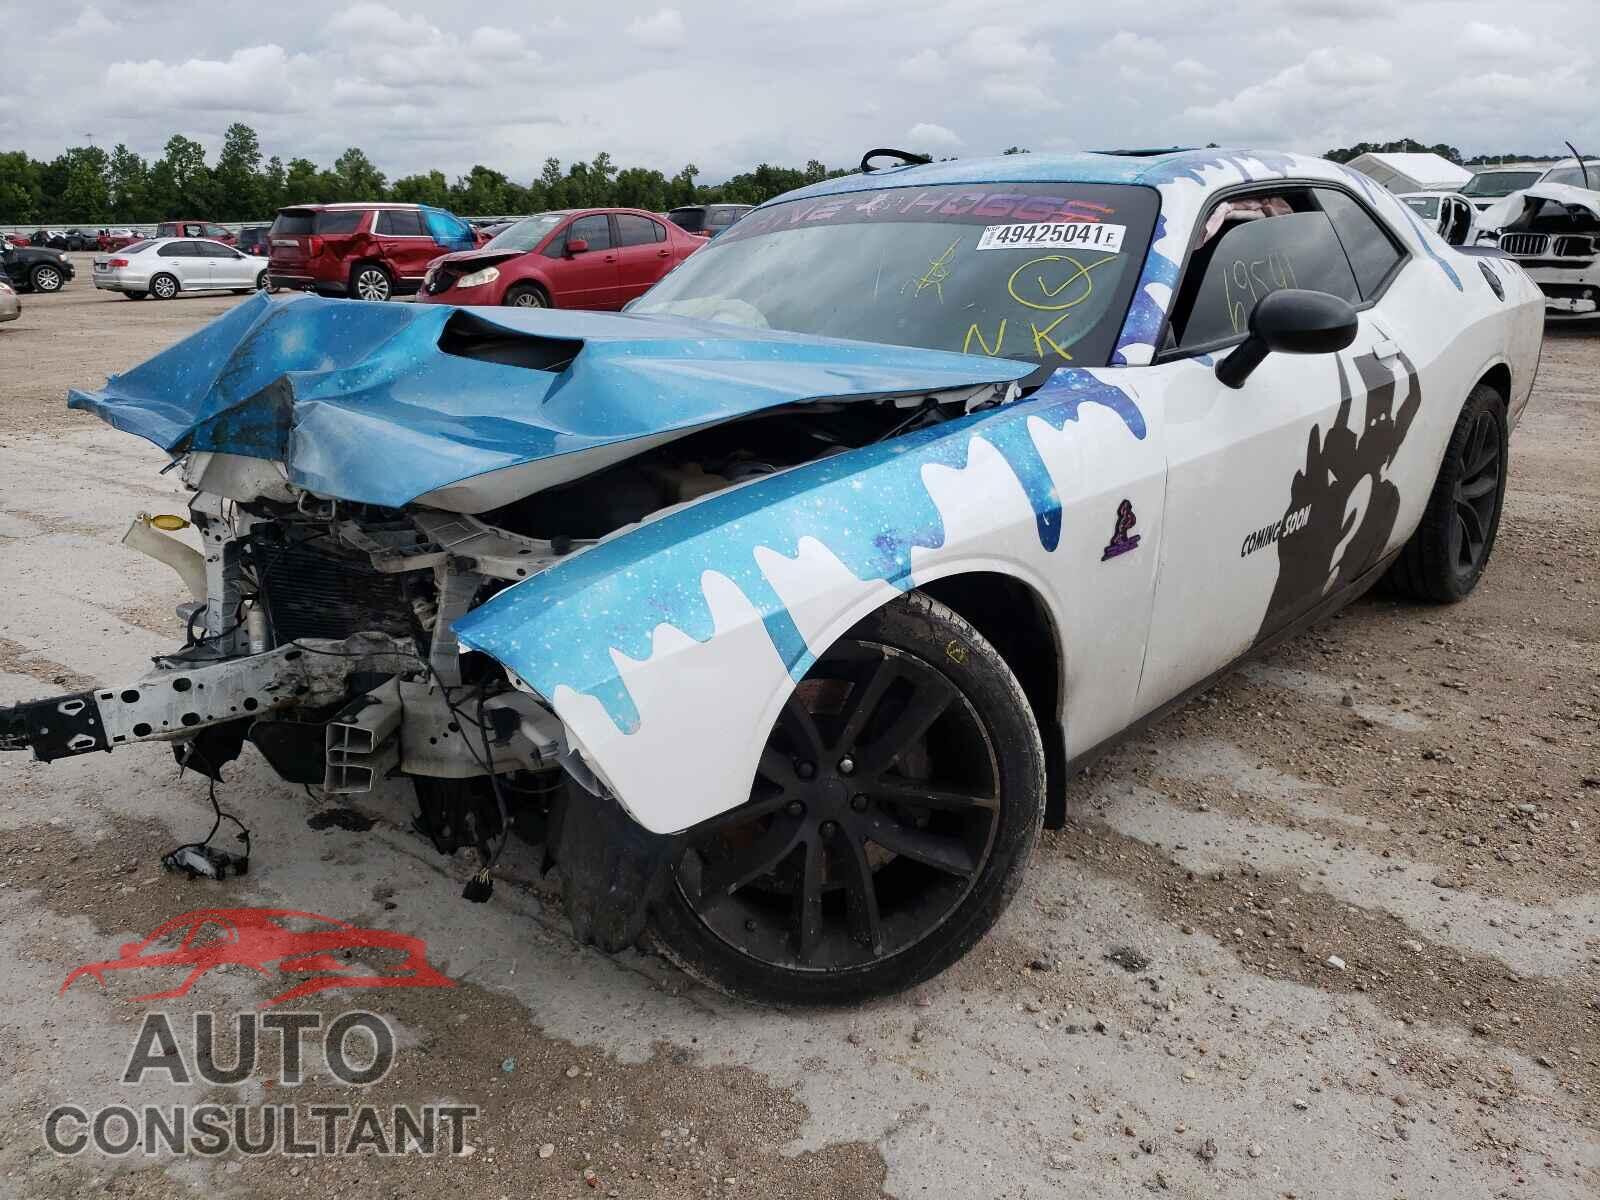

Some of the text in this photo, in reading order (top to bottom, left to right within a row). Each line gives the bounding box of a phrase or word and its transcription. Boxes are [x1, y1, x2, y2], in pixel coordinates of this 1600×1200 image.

[996, 224, 1104, 244] 49425041
[1105, 232, 1115, 243] F
[1240, 503, 1312, 558] COMING SOON
